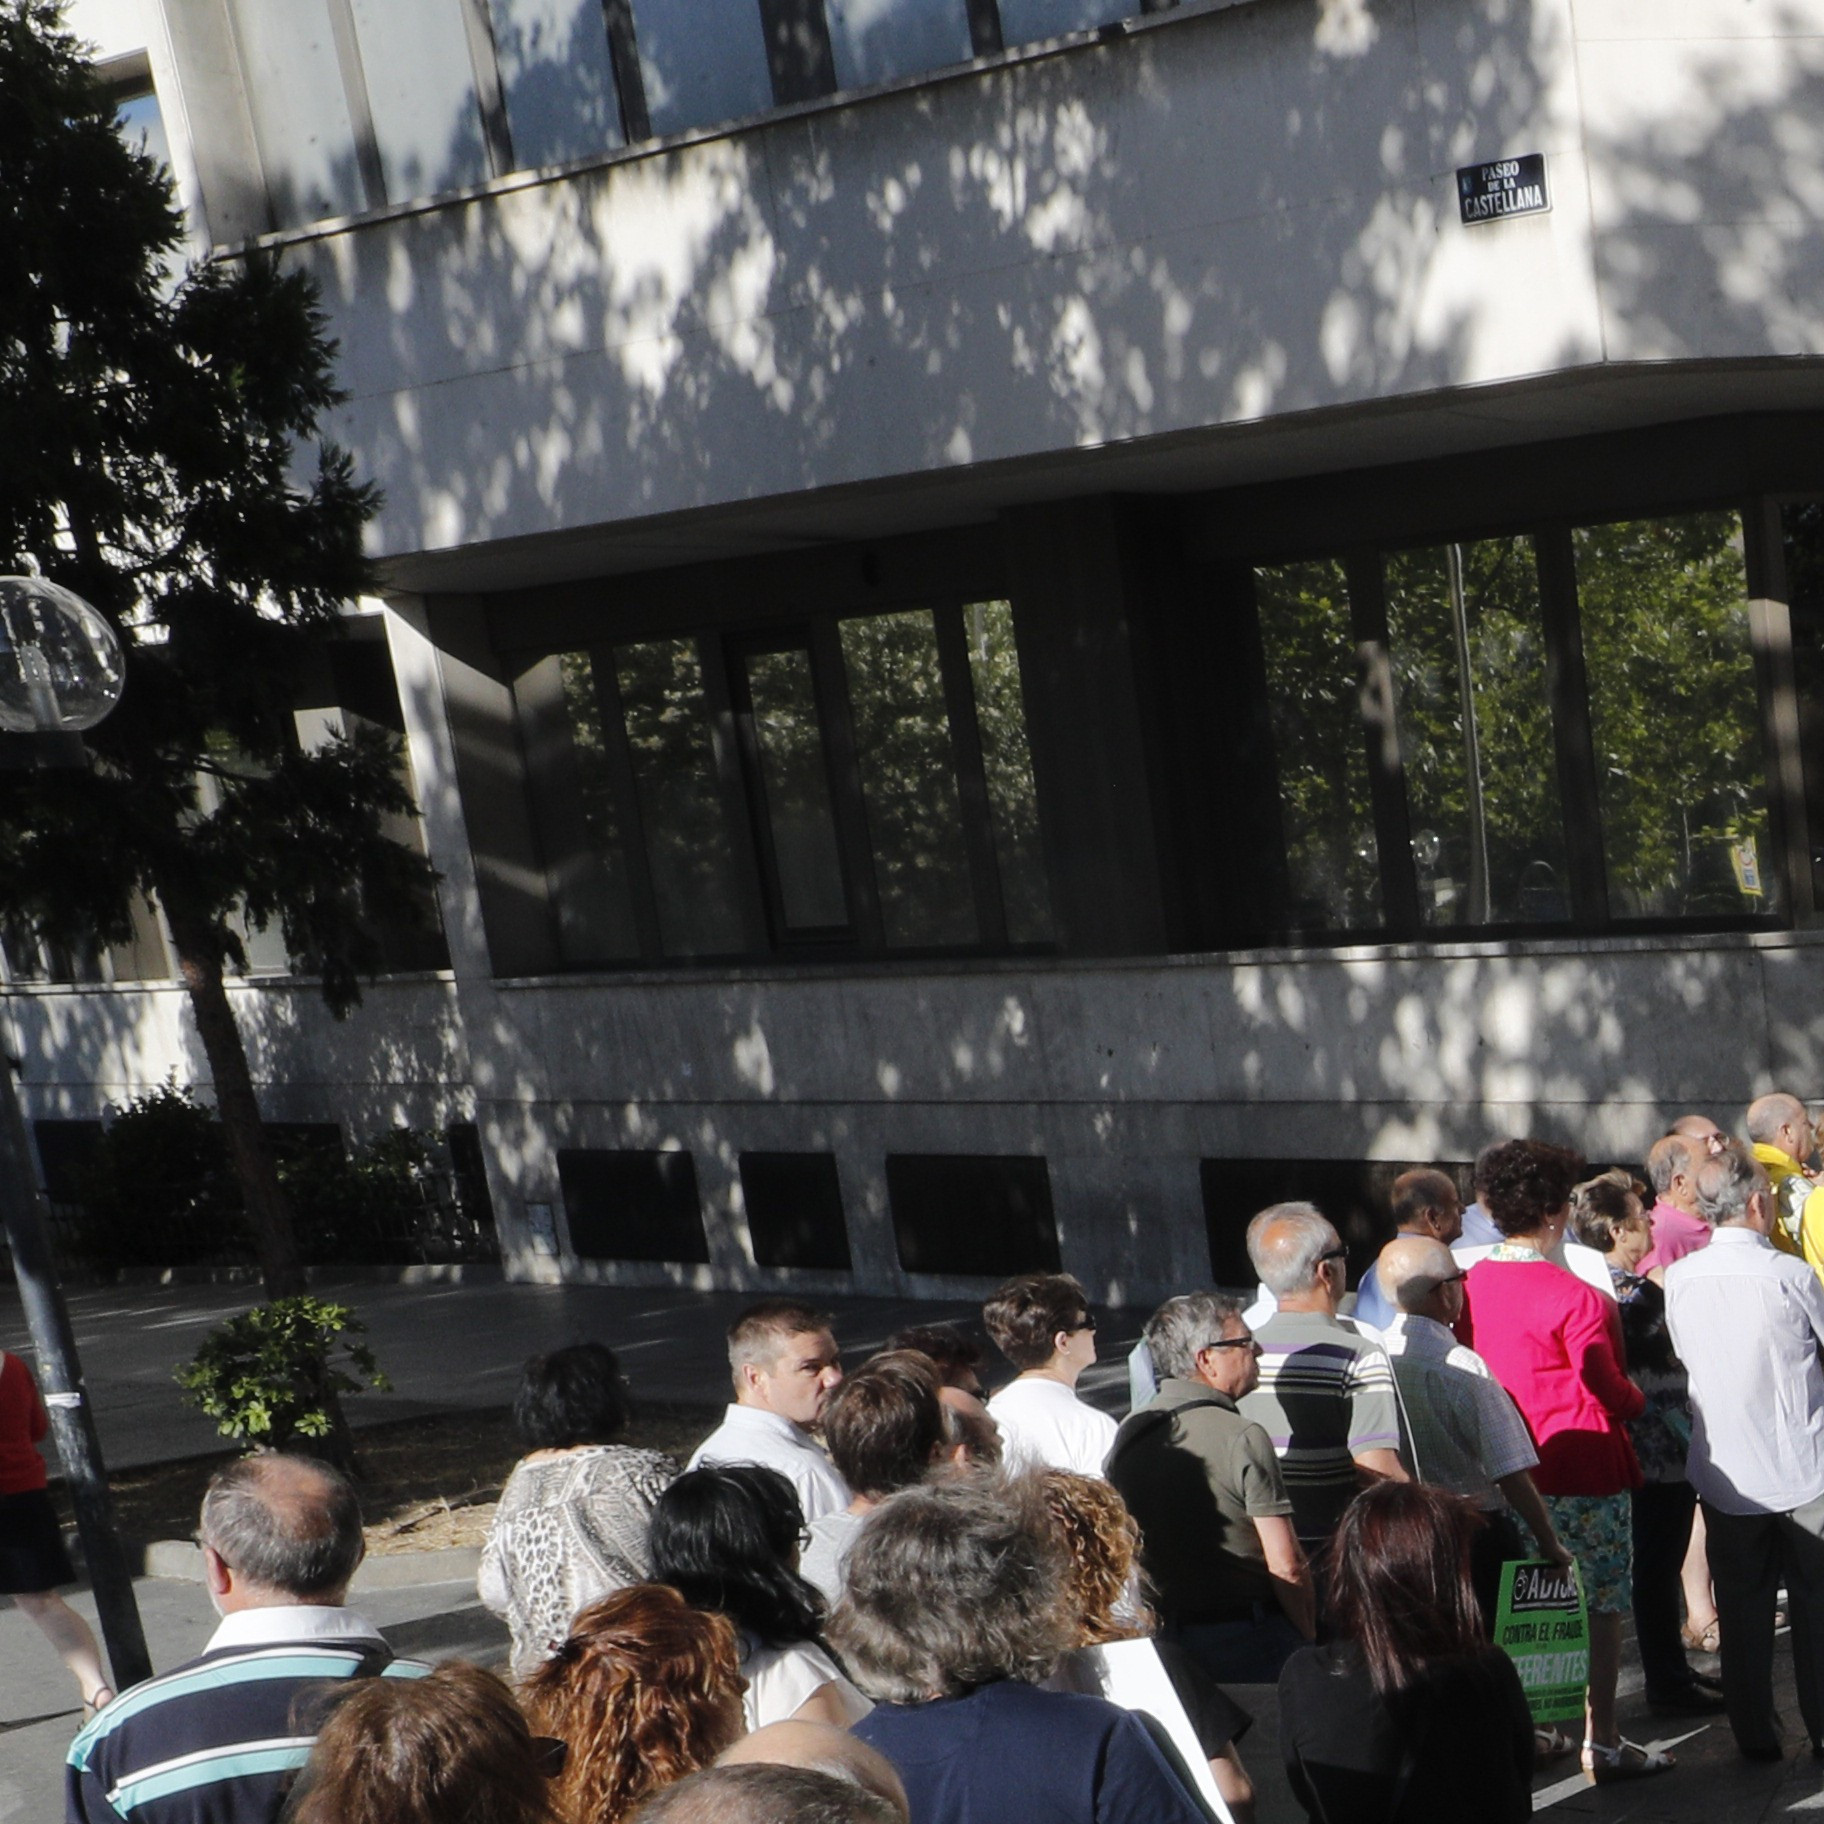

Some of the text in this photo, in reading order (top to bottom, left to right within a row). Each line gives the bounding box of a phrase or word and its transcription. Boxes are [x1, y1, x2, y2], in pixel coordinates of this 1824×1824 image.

[1481, 160, 1520, 181] PASEO
[1487, 177, 1516, 192] DE LA
[1463, 184, 1543, 219] CASTELLANA
[1503, 1618, 1583, 1645] CONTRA EL FRAUDE
